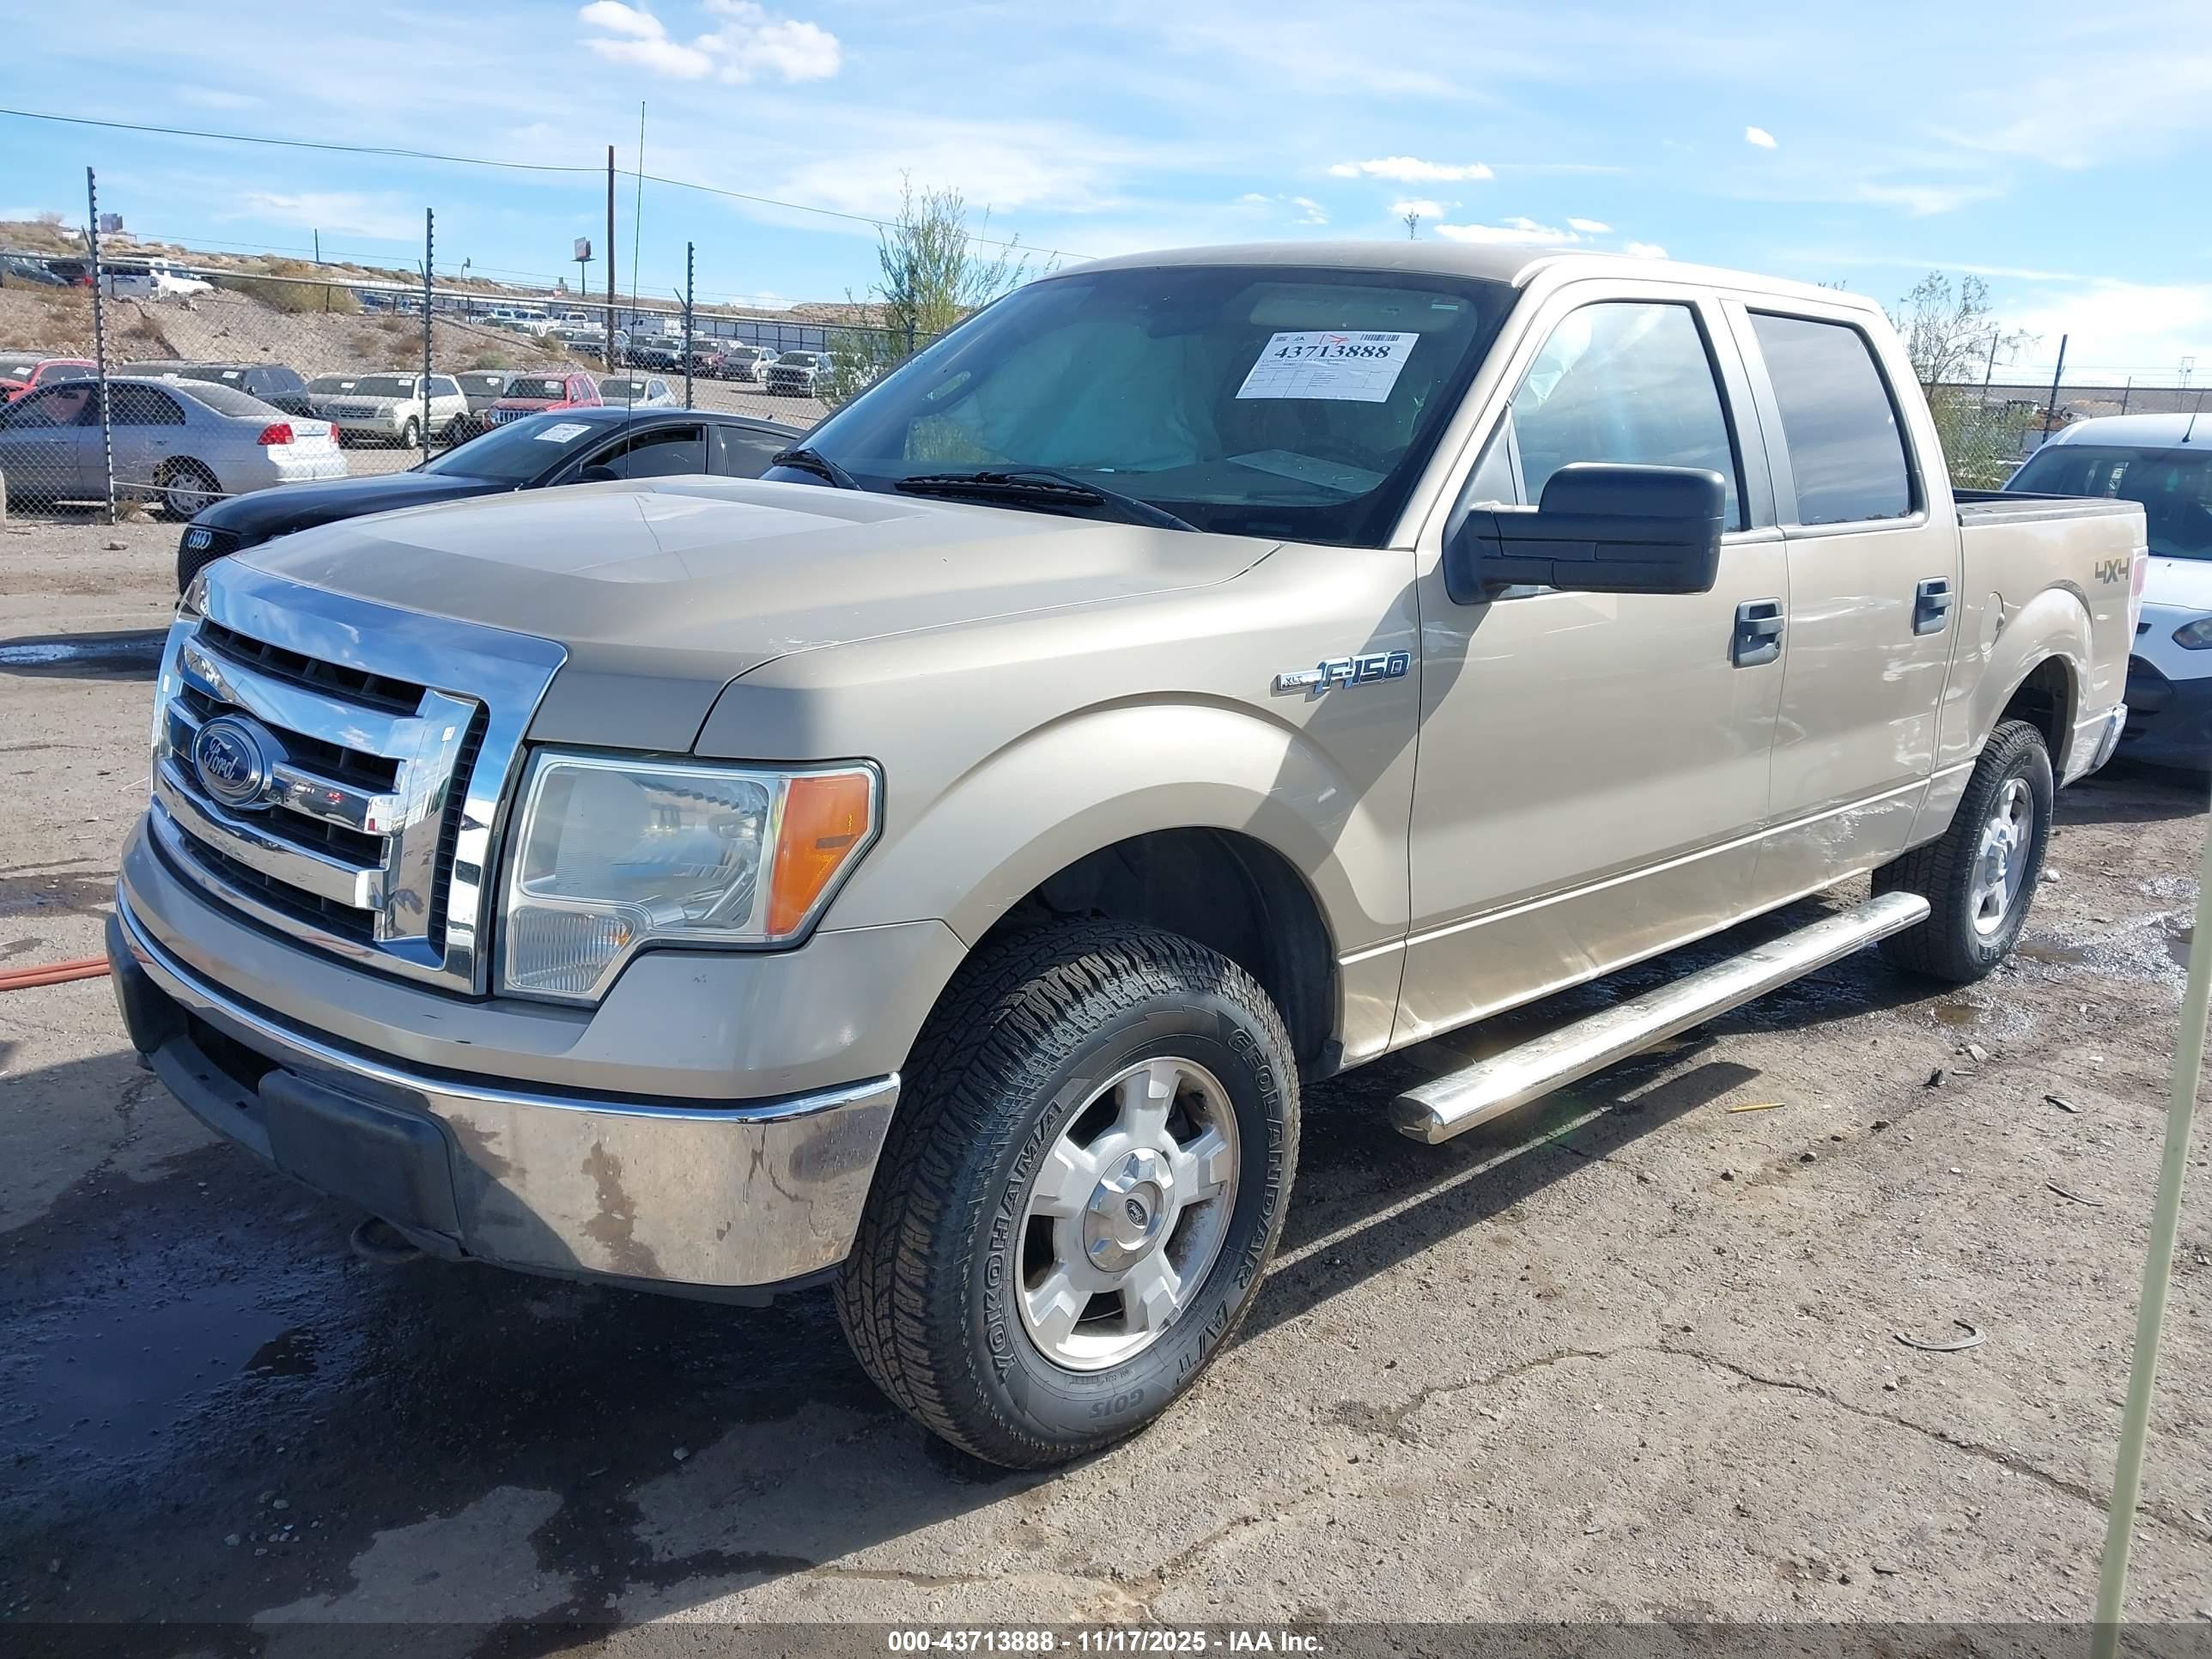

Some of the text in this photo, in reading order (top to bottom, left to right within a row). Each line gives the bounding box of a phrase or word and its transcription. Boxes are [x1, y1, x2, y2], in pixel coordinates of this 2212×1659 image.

[1274, 344, 1391, 359] 43713888
[1285, 650, 1411, 694] XLT F-150
[204, 736, 239, 780] Ford
[1226, 1027, 1285, 1291] GEOLANDAR
[983, 1099, 1063, 1385] YOKOHAMA
[1088, 1388, 1145, 1419] G015
